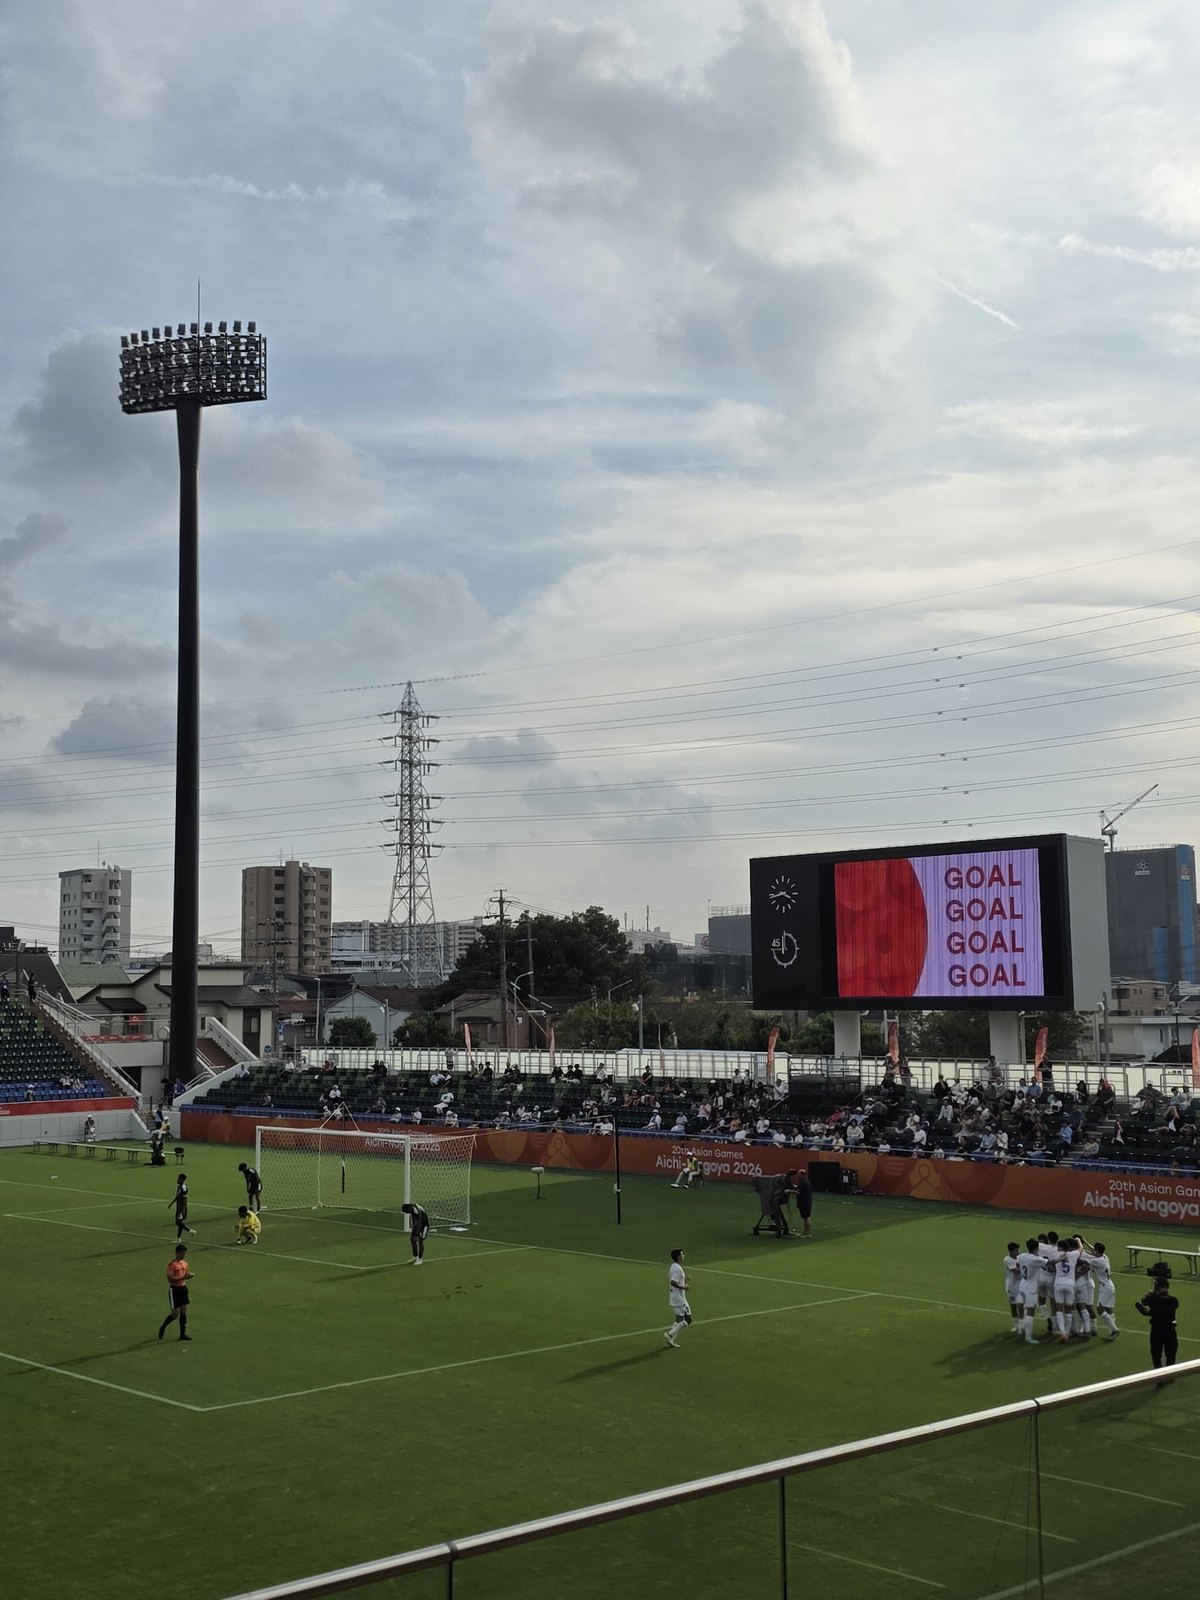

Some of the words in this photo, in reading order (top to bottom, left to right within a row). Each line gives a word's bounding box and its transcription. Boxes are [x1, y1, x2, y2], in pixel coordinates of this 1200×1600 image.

[945, 863, 1022, 890] GOAL
[946, 896, 1023, 922] GOAL
[771, 938, 781, 948] 45
[947, 930, 1025, 955] GOAL
[948, 963, 1026, 988] GOAL
[672, 1145, 689, 1156] 20th
[691, 1146, 713, 1157] Asian
[715, 1148, 744, 1160] Games
[656, 1154, 731, 1176] Aichi-goya
[733, 1161, 763, 1176] 2026
[1108, 1179, 1136, 1192] 20th
[1139, 1181, 1172, 1195] Asian
[1083, 1190, 1200, 1219] Aichi-Nagoya
[1022, 1265, 1028, 1280] 3
[1061, 1260, 1071, 1274] 5
